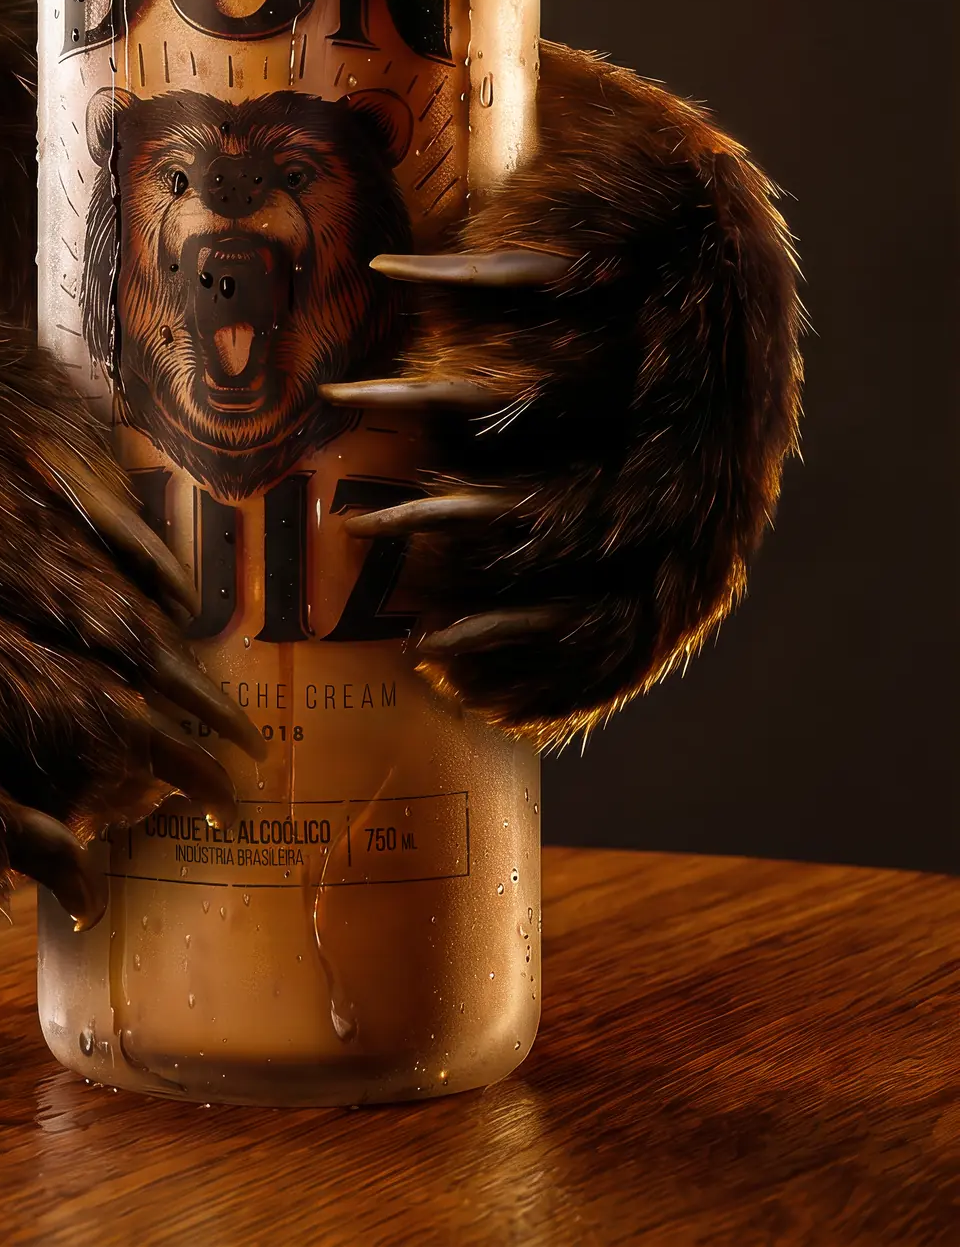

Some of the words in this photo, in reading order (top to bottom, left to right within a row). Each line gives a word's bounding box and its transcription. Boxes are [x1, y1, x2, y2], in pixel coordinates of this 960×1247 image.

[305, 681, 397, 710] CREAM
[261, 724, 305, 742] 018
[364, 827, 397, 852] 750
[401, 832, 418, 852] ML
[175, 843, 235, 866] INDÚSTRIA
